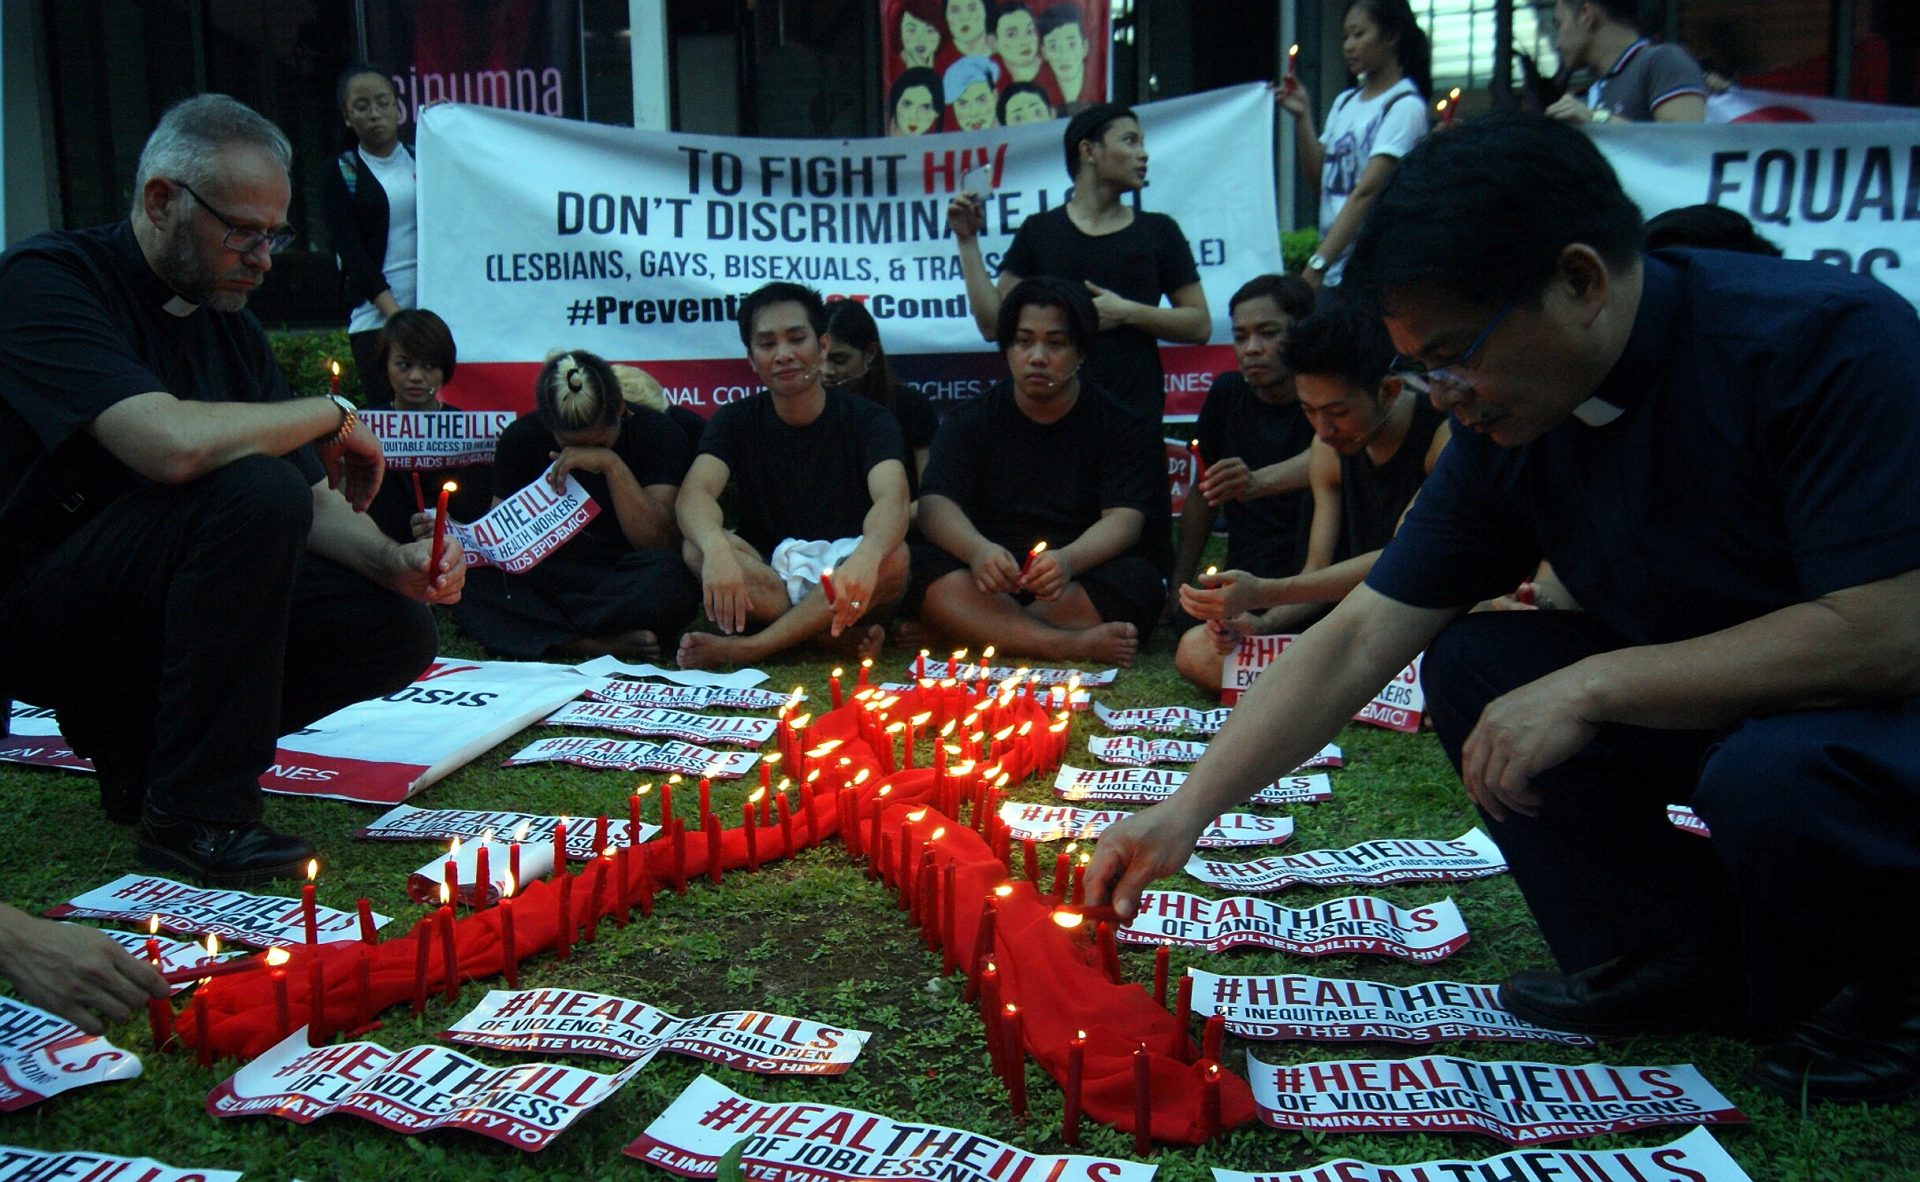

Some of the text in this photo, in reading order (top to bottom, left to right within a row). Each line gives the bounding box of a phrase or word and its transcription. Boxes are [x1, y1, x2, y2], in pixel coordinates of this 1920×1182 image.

[678, 145, 743, 197] TO
[759, 154, 908, 198] FIGHT
[557, 190, 693, 239] DON'T
[485, 249, 632, 283] (LESBIANS,
[639, 250, 716, 280] GAYS,
[724, 254, 880, 284] BISEXUALS,
[888, 258, 906, 282] &
[414, 456, 443, 468] AIDS
[425, 441, 460, 451] ACCESS
[499, 530, 532, 559] HEALTH
[530, 494, 579, 536] WORKERS
[505, 508, 590, 572] AIDS EPIDEMIC!
[571, 703, 768, 733] #HEALTHEILLS
[1097, 783, 1173, 794] VIOLENCE
[1204, 841, 1479, 877] #HEALTHEILLS
[1139, 893, 1439, 933] #HEALTHEILLS
[1161, 918, 1407, 945] OF LANDLESSNESS
[1381, 942, 1410, 956] TO
[1411, 944, 1451, 960] HIV!
[493, 990, 844, 1050] #HEALTHEILLS
[1245, 1007, 1379, 1022] INEQUITABLE
[1385, 1008, 1465, 1024] ACCESS
[1468, 1009, 1496, 1025] TO
[476, 1020, 510, 1031] OF
[511, 1017, 618, 1034] VIOLENCE
[718, 1030, 834, 1061] CHILDREN
[1288, 1024, 1350, 1038] THE
[1357, 1025, 1431, 1041] AIDS
[1438, 1024, 1595, 1046] EPIDEMIC!
[451, 1033, 569, 1049] ELIMINATE
[745, 1057, 779, 1070] TO
[779, 1063, 827, 1073] HIV!
[285, 1073, 336, 1092] OF
[1273, 1058, 1685, 1104] #HEALTHEILLS
[1277, 1087, 1702, 1125] OF VIOLENCE IN PRISONS
[507, 1122, 543, 1144] TO
[1272, 1112, 1718, 1142] ELIMINATE VULNERABILITY TO HIV!
